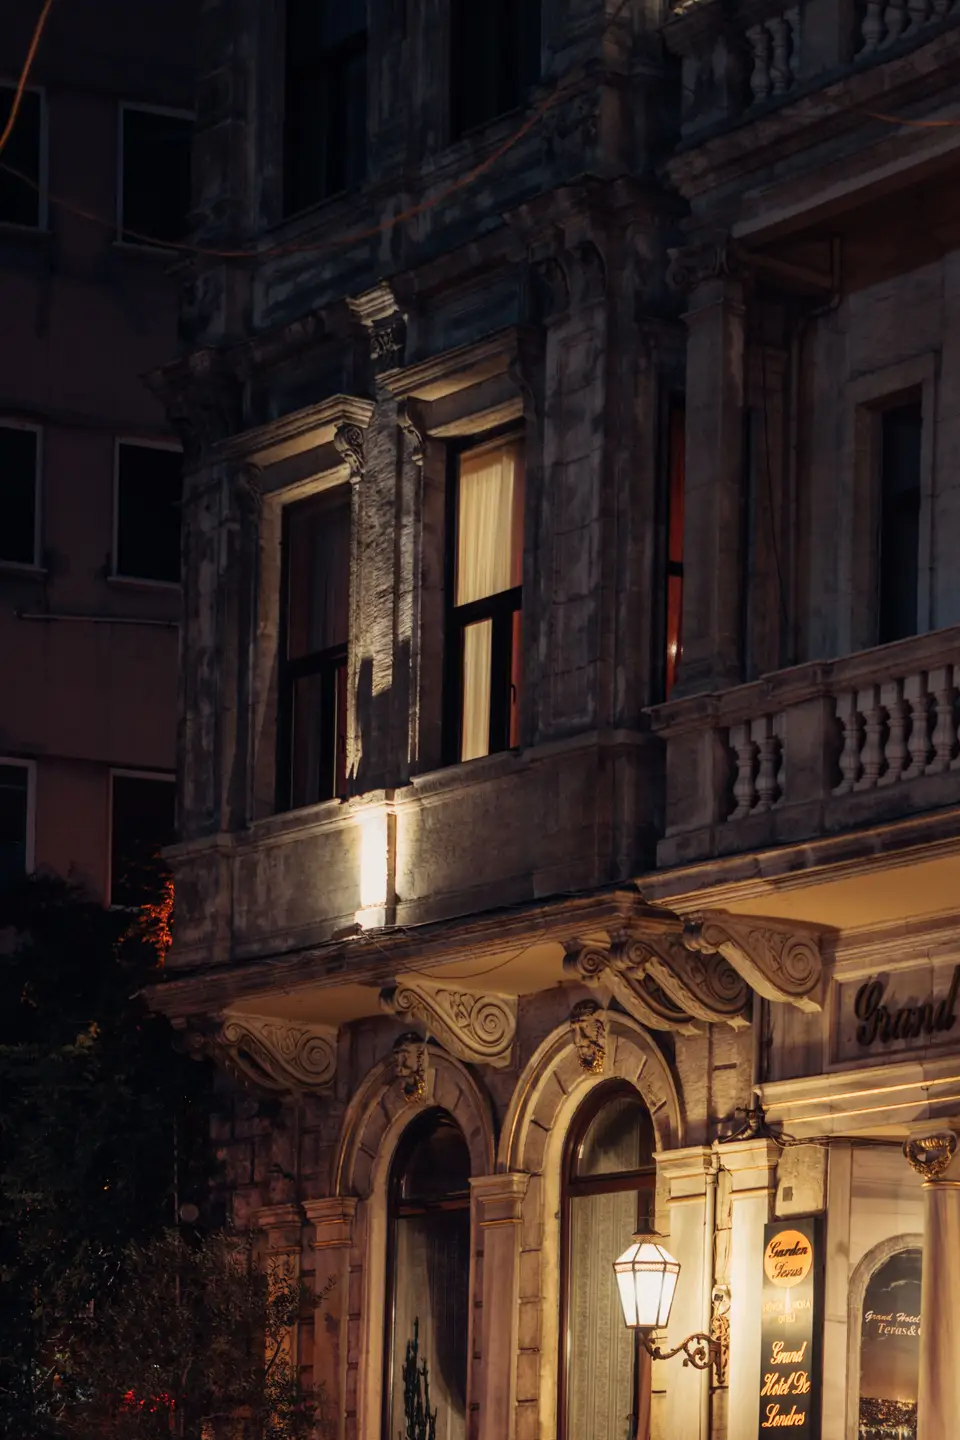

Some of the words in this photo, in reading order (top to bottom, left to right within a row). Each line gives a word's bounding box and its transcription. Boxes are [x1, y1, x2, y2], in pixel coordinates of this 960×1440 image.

[769, 1241, 808, 1259] Garden
[864, 1310, 894, 1323] Grand
[896, 1312, 921, 1323] Hotel
[770, 1341, 807, 1364] Grand
[760, 1372, 796, 1396] Hotel
[792, 1370, 811, 1394] De
[762, 1403, 805, 1428] Londres
